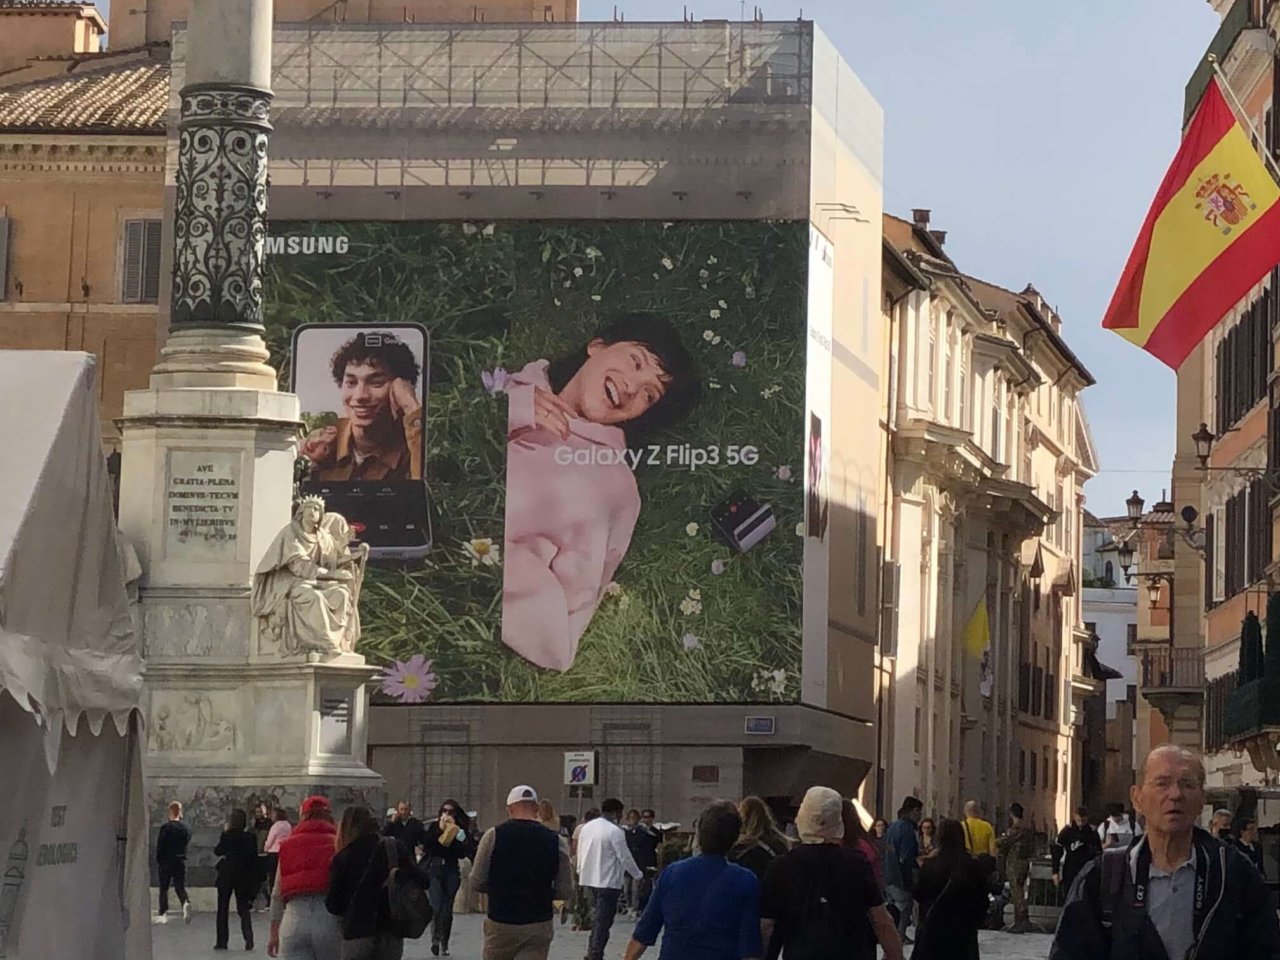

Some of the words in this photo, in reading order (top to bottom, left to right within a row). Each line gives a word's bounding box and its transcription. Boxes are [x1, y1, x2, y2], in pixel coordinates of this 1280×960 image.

[265, 236, 349, 254] MSUNG
[553, 445, 643, 470] Galaxy
[647, 446, 661, 465] Z
[666, 443, 720, 471] Flip3
[726, 445, 760, 466] 5G
[196, 464, 214, 472] AVE
